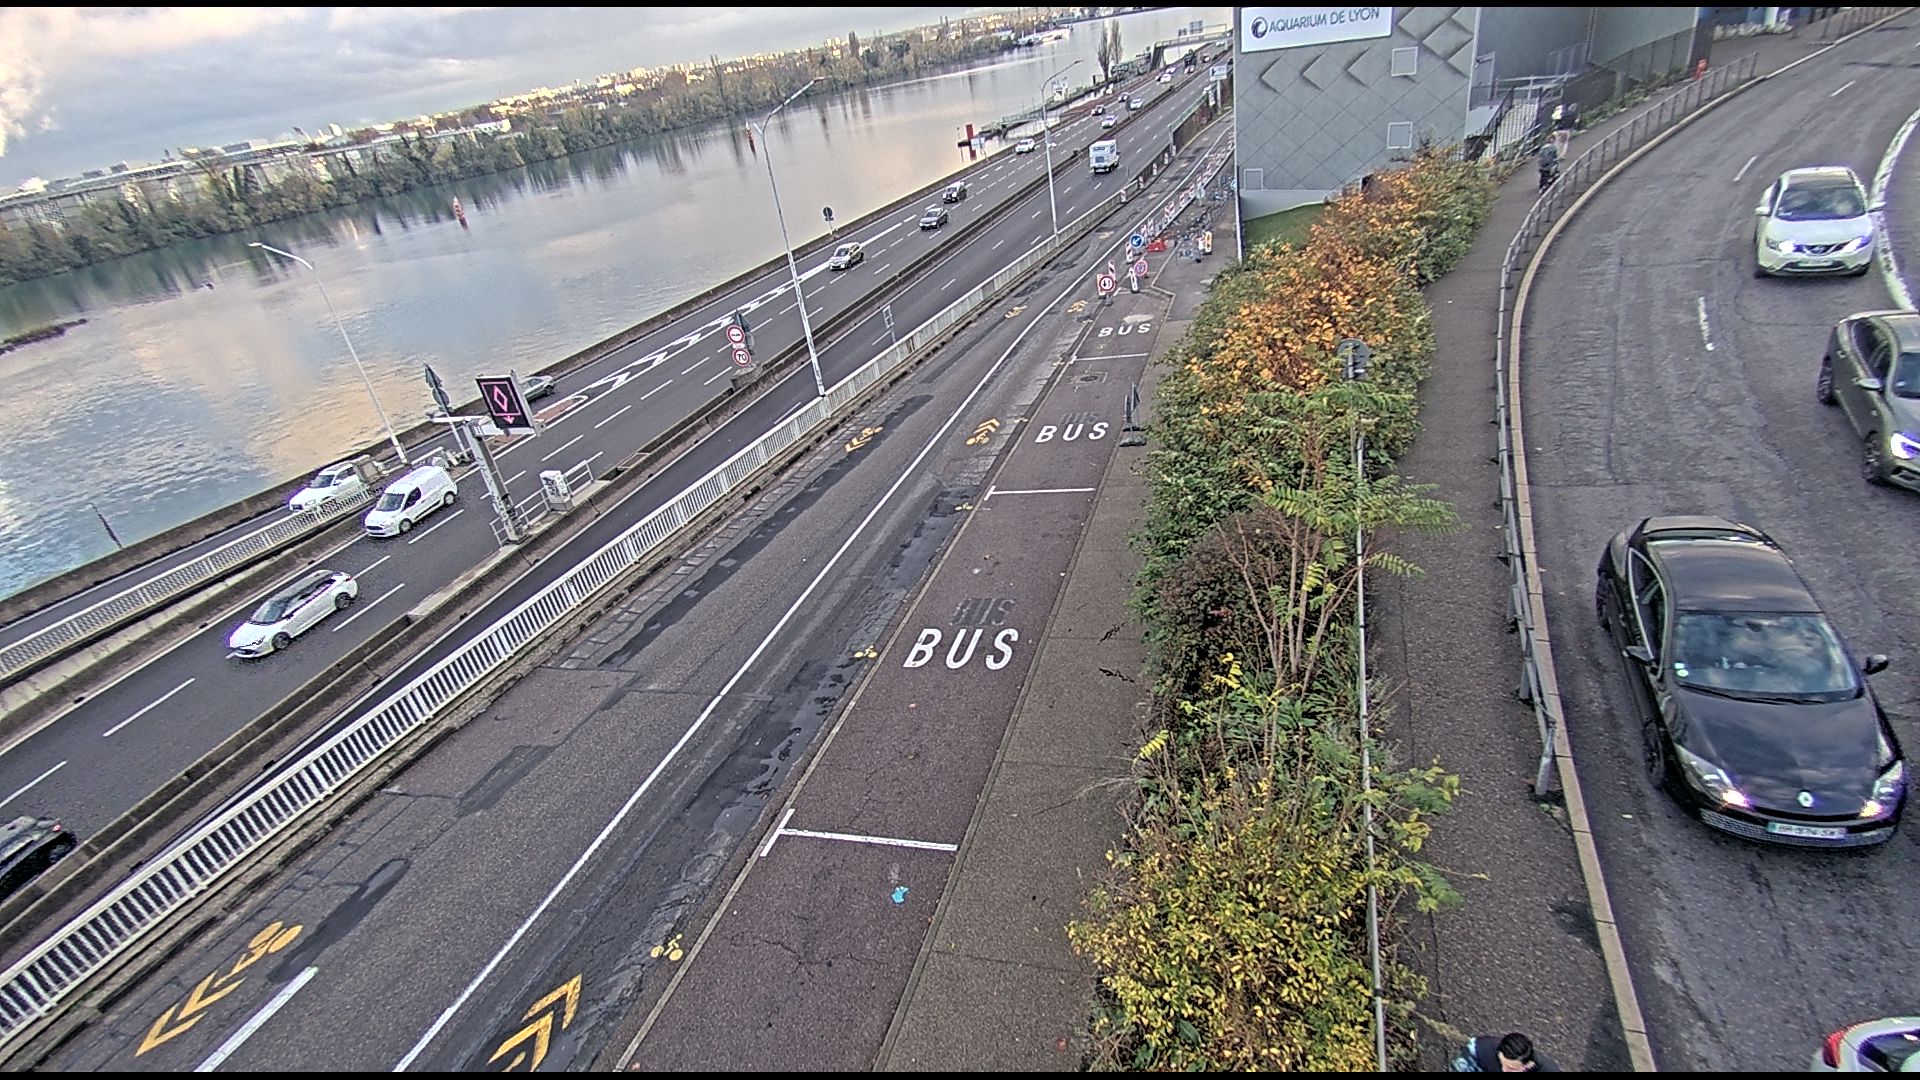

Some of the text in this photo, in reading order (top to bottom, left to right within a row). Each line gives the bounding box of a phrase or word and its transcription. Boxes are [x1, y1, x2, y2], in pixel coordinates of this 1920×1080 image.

[1269, 8, 1380, 32] AQUARIUM DE LYON
[1098, 323, 1151, 338] BUS
[737, 353, 747, 361] 70
[1035, 422, 1109, 443] BUS
[903, 628, 1019, 670] BUS
